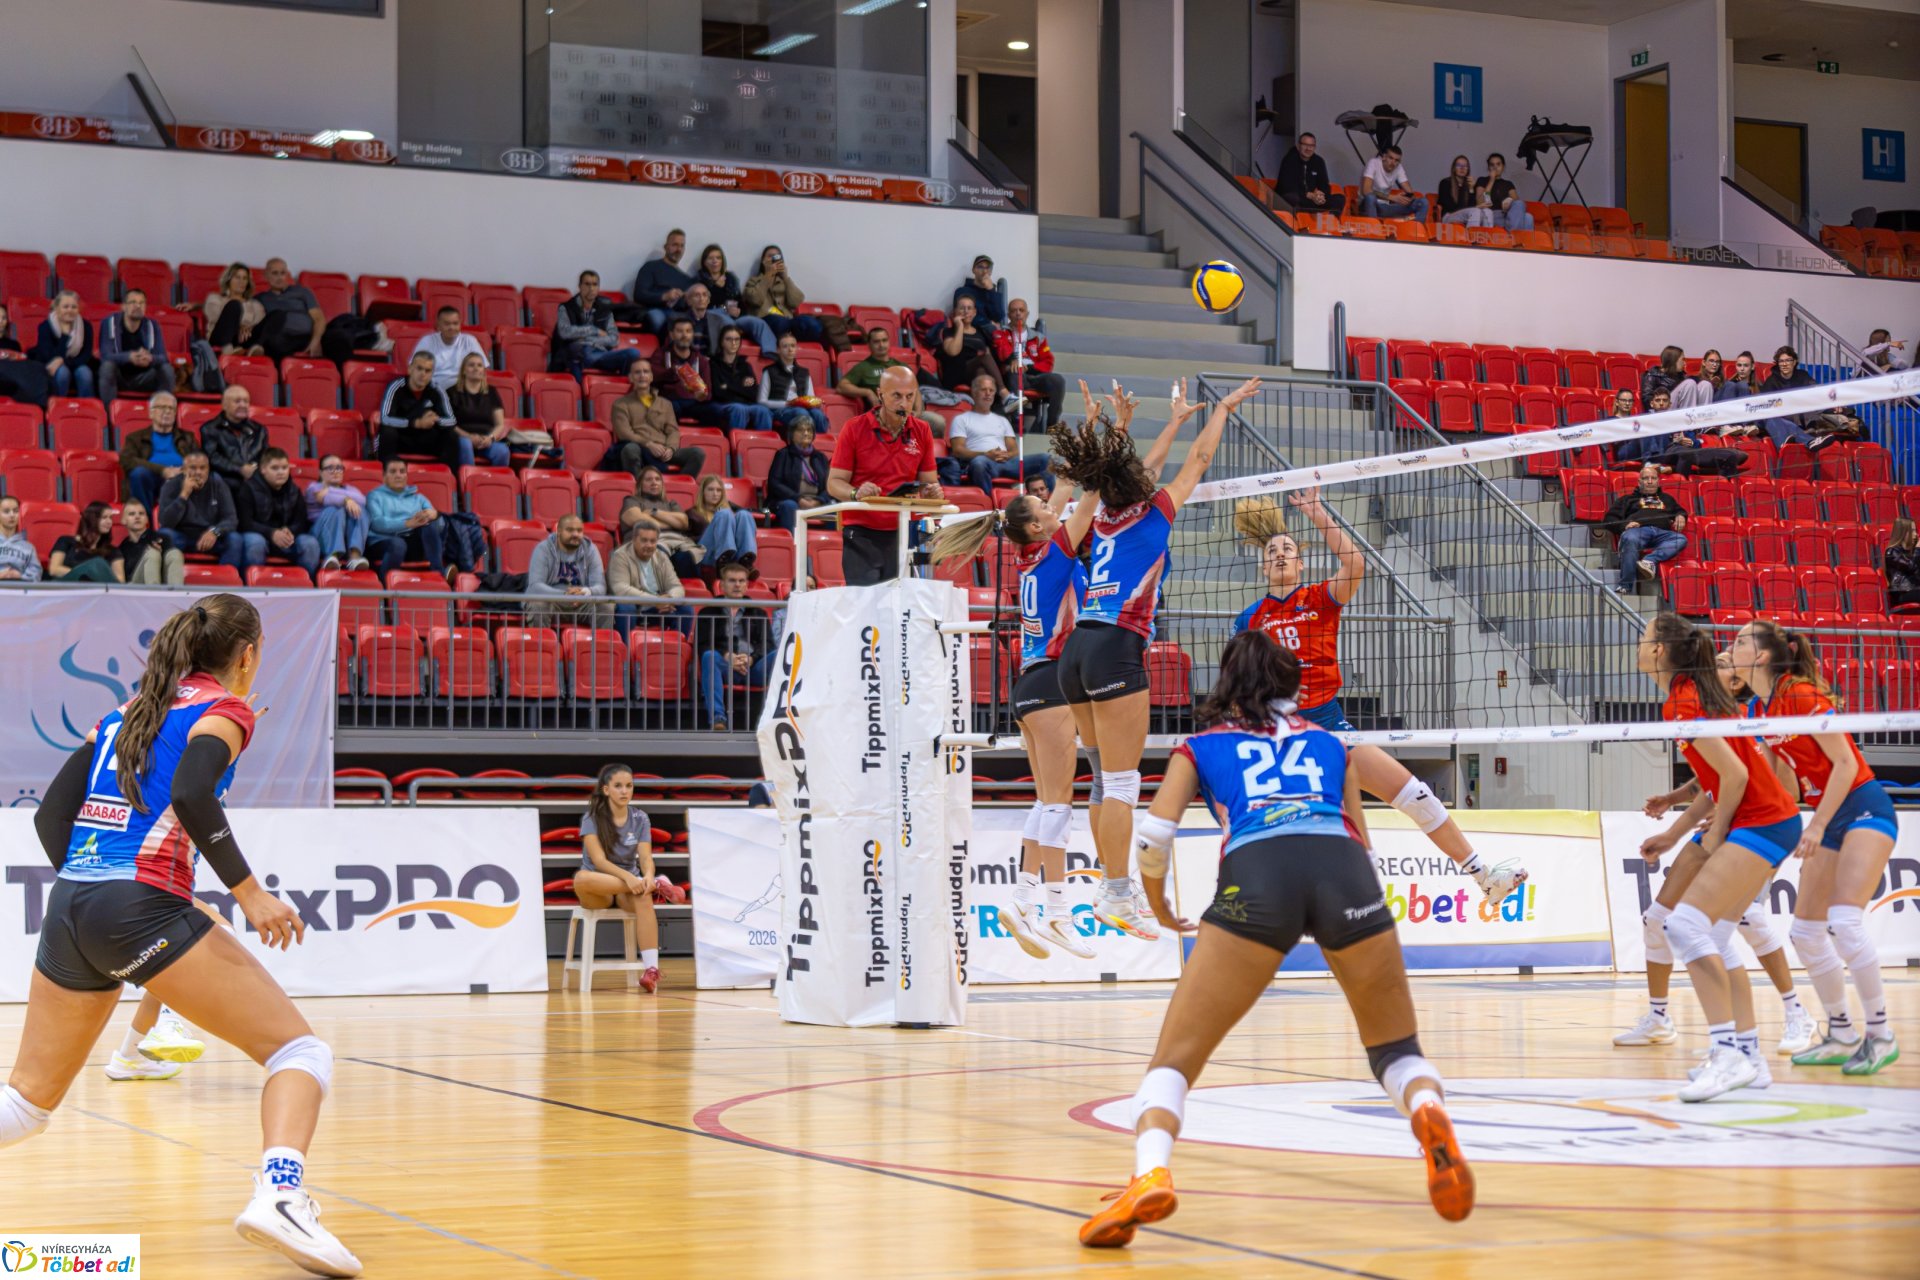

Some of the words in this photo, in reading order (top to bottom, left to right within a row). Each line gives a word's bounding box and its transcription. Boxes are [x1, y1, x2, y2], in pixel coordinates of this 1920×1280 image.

[40, 115, 71, 135] BH
[206, 130, 237, 148] BH
[361, 142, 391, 160] BH
[508, 153, 536, 169] BH
[572, 154, 607, 167] Holding
[652, 163, 677, 180] BH
[690, 163, 711, 176] Bige
[712, 165, 747, 178] Holding
[701, 175, 737, 187] Csoport
[790, 174, 816, 191] BH
[849, 176, 882, 188] Holding
[838, 186, 872, 198] Csoport
[982, 186, 1014, 198] Holding
[971, 197, 1004, 207] Csoport
[1091, 539, 1116, 584] 2
[1276, 626, 1301, 650] 18
[901, 608, 911, 706] TippmixPRO
[861, 626, 887, 774] TippmixPRO
[1236, 739, 1324, 798] 24
[771, 632, 820, 982] TippmixPRO
[901, 752, 912, 849] TippmixPRO
[80, 803, 128, 822] TRABAG
[1385, 883, 1469, 923] bbet
[864, 840, 891, 989] TippmixPRO
[949, 840, 967, 986] TippmixPRO
[748, 930, 777, 946] 2026
[900, 893, 911, 990] TippmixPRO
[111, 938, 169, 979] TippmixPRO
[272, 1172, 301, 1188] DO
